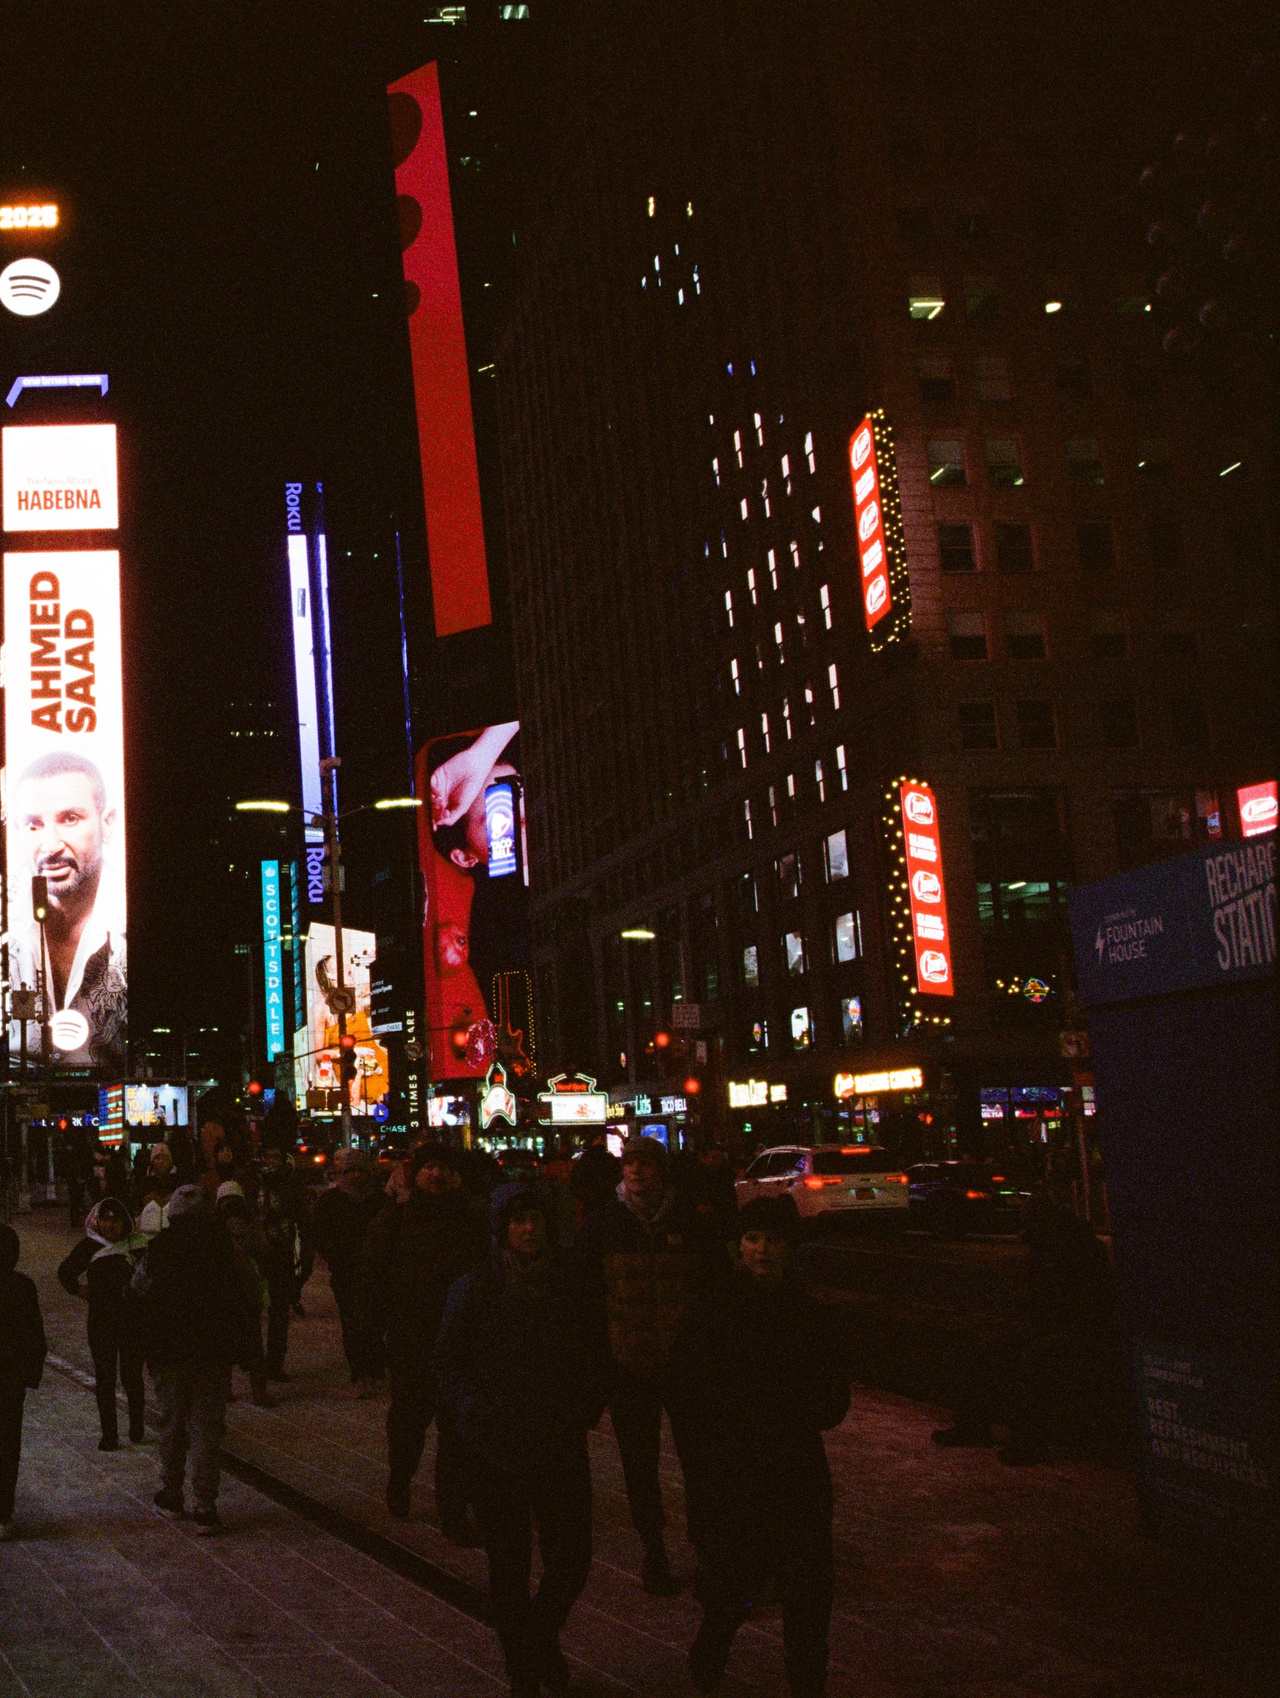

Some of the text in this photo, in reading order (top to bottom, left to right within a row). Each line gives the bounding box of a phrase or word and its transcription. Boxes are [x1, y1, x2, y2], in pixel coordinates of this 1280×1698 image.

[17, 489, 101, 510] HABEBNA
[29, 570, 63, 734] AHMED
[64, 608, 97, 733] SAAD
[1106, 914, 1164, 945] FOUNTAIN
[265, 884, 280, 1035] SCOTTSDALE
[1109, 939, 1149, 964] HOUSE
[408, 1074, 418, 1113] TIMES
